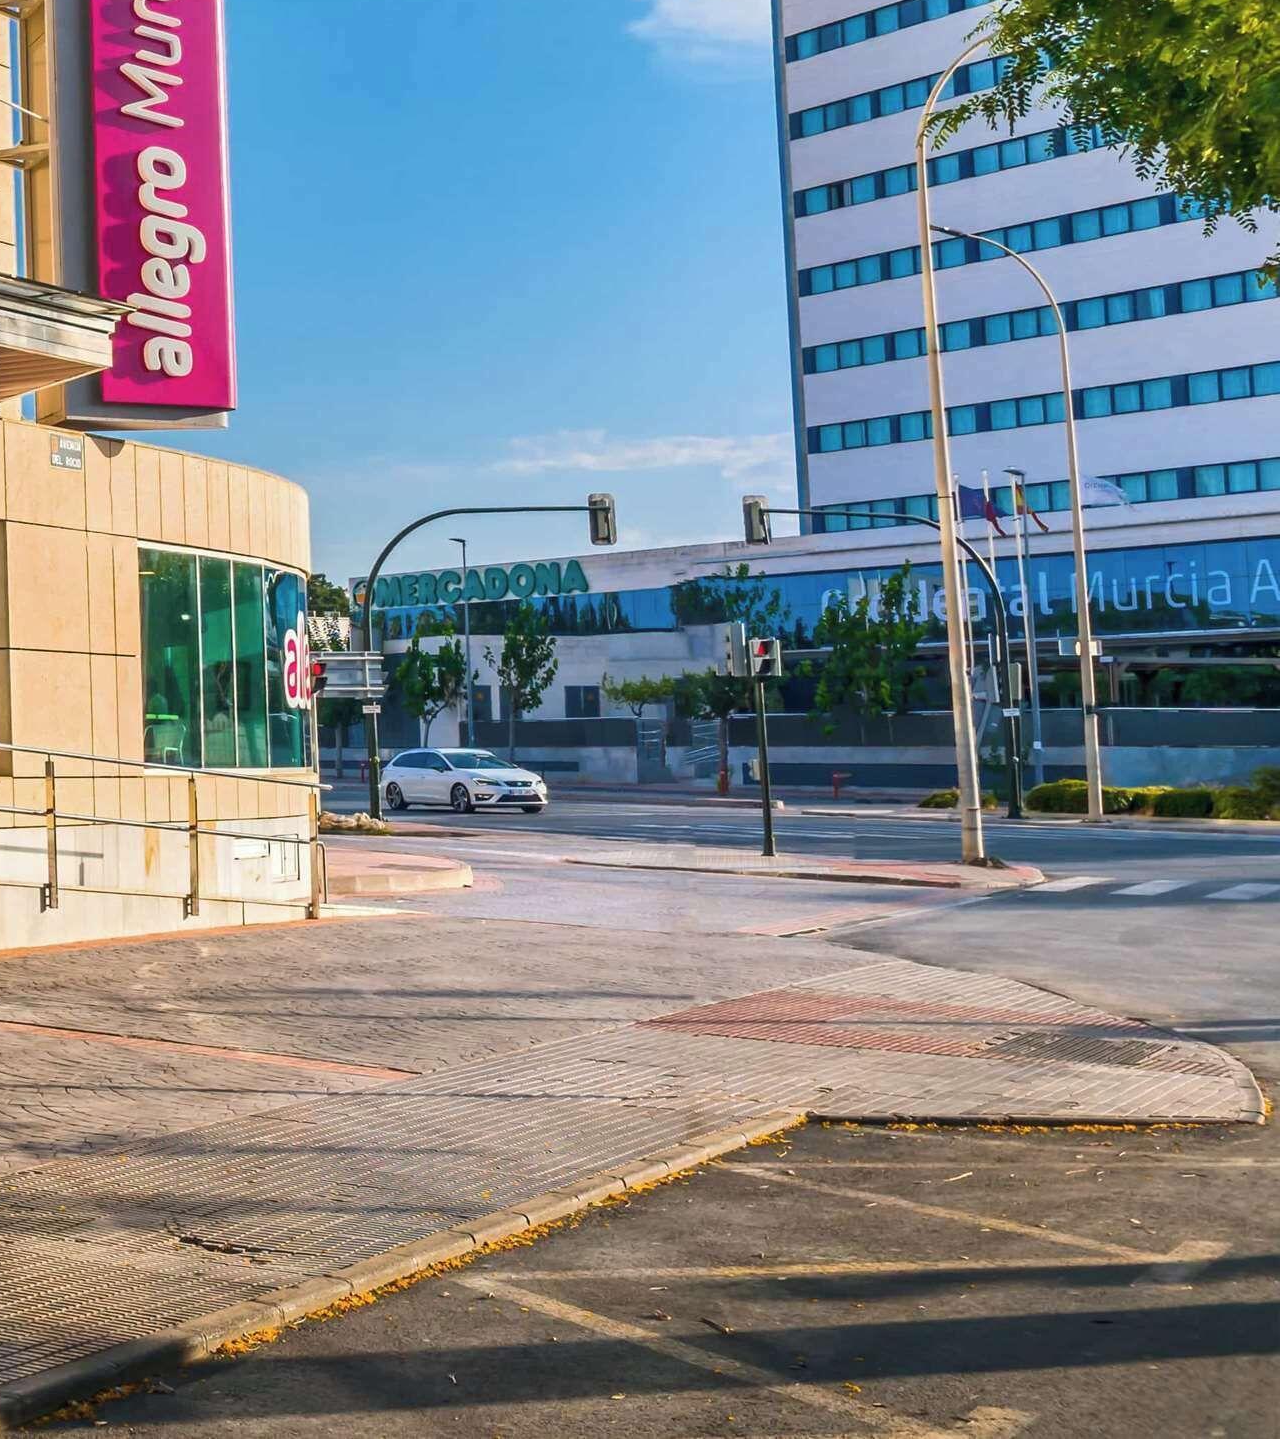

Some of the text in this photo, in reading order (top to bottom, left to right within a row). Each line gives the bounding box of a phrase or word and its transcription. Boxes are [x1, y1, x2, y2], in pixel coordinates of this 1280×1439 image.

[126, 145, 207, 378] allegro
[375, 559, 589, 607] MERCADONA
[1071, 561, 1232, 614] Murcia
